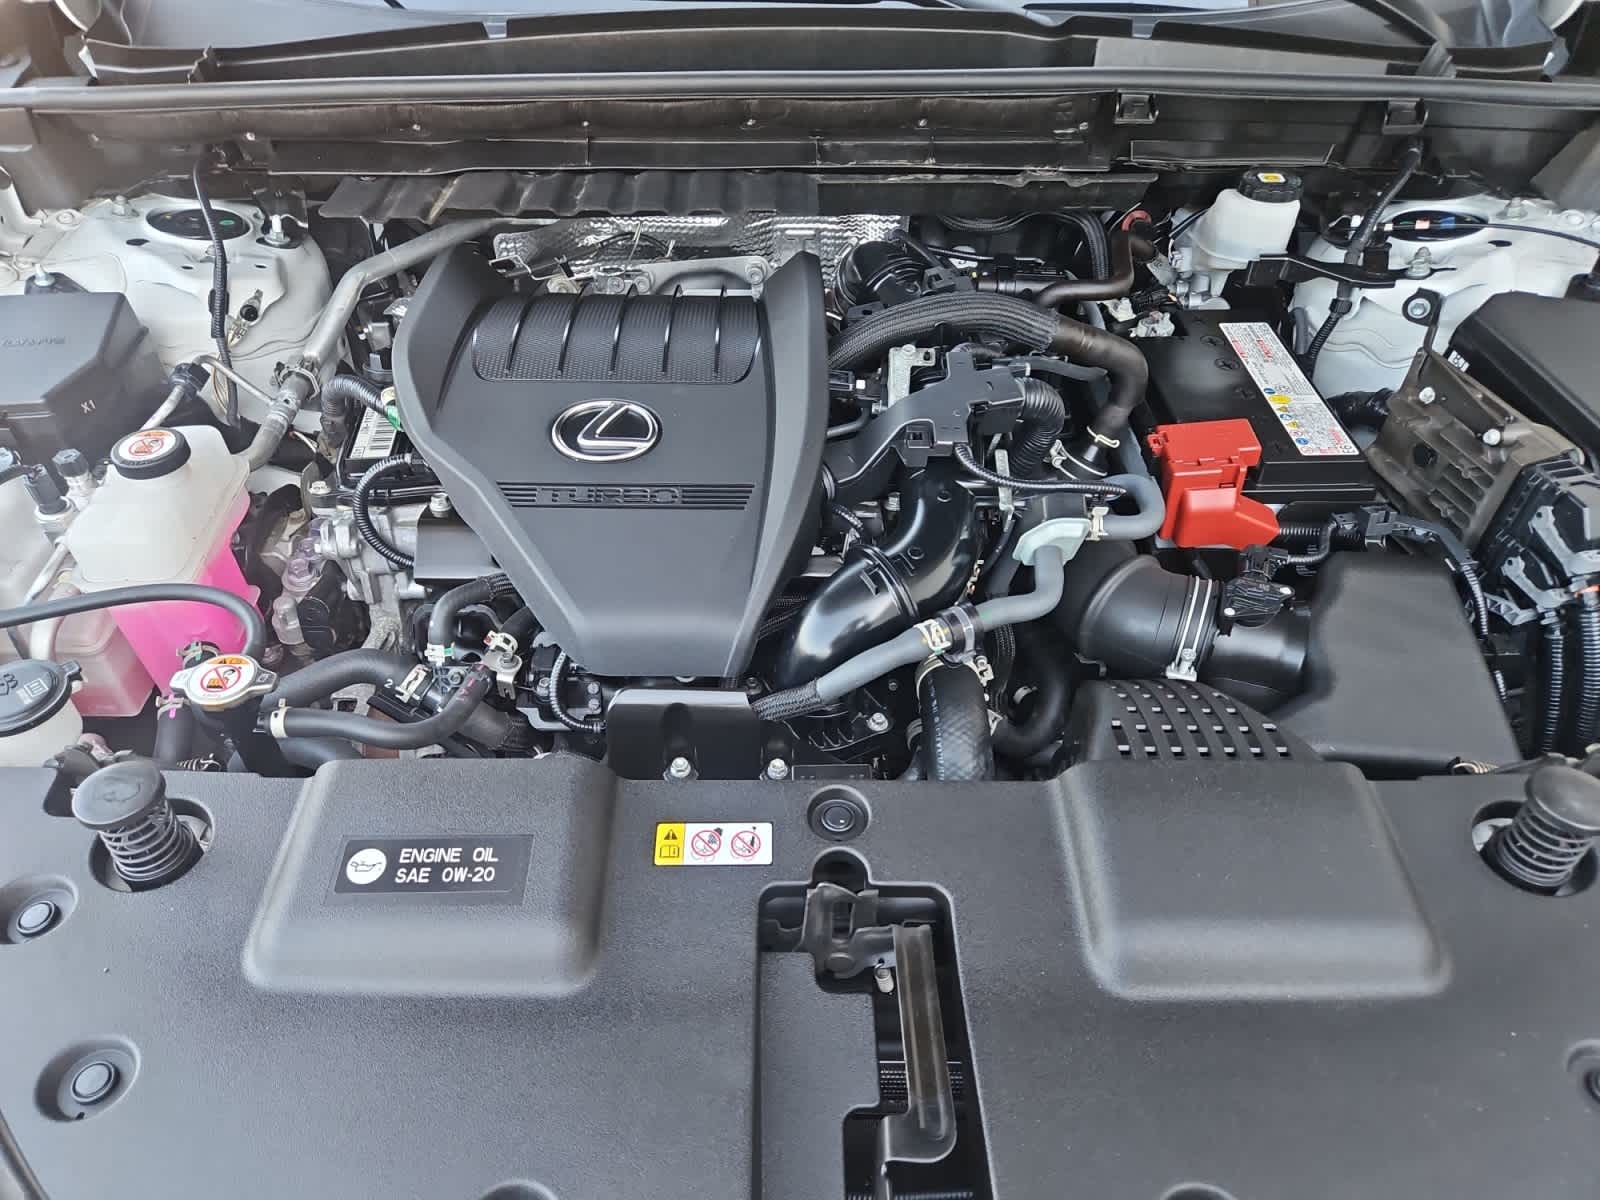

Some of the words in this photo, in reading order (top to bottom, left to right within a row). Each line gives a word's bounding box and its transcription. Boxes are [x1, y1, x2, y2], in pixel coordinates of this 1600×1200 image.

[539, 487, 680, 504] TURBO
[399, 847, 463, 863] ENGINE
[472, 847, 499, 862] OIL
[395, 867, 432, 883] SAE
[441, 866, 496, 882] 0W-20
